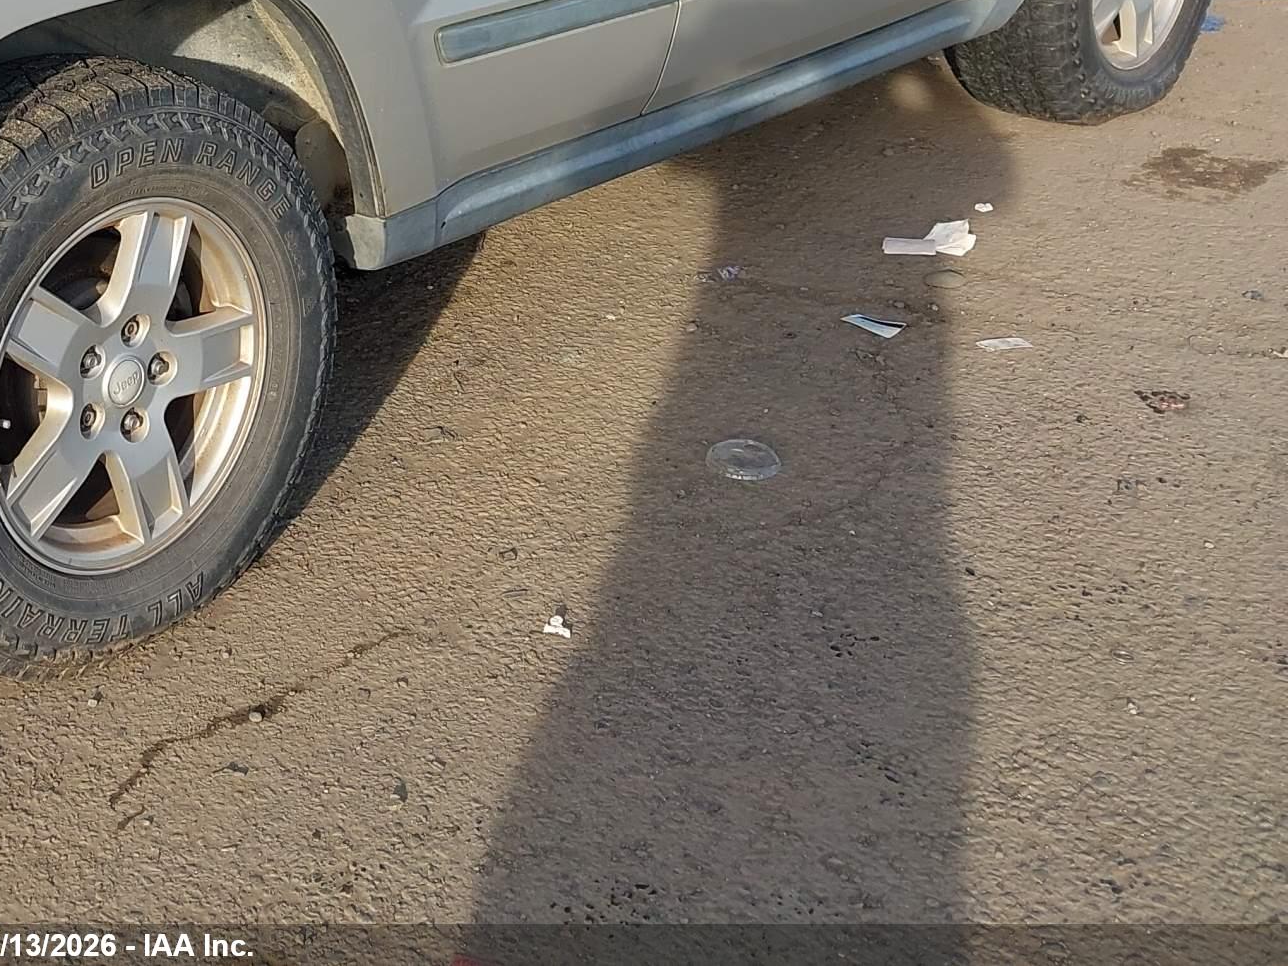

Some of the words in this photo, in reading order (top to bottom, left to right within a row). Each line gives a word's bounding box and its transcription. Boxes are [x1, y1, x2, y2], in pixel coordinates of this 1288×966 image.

[90, 137, 185, 190] OPEN
[193, 139, 292, 220] RANGE
[113, 370, 139, 395] Jeep
[147, 571, 205, 628] ALL
